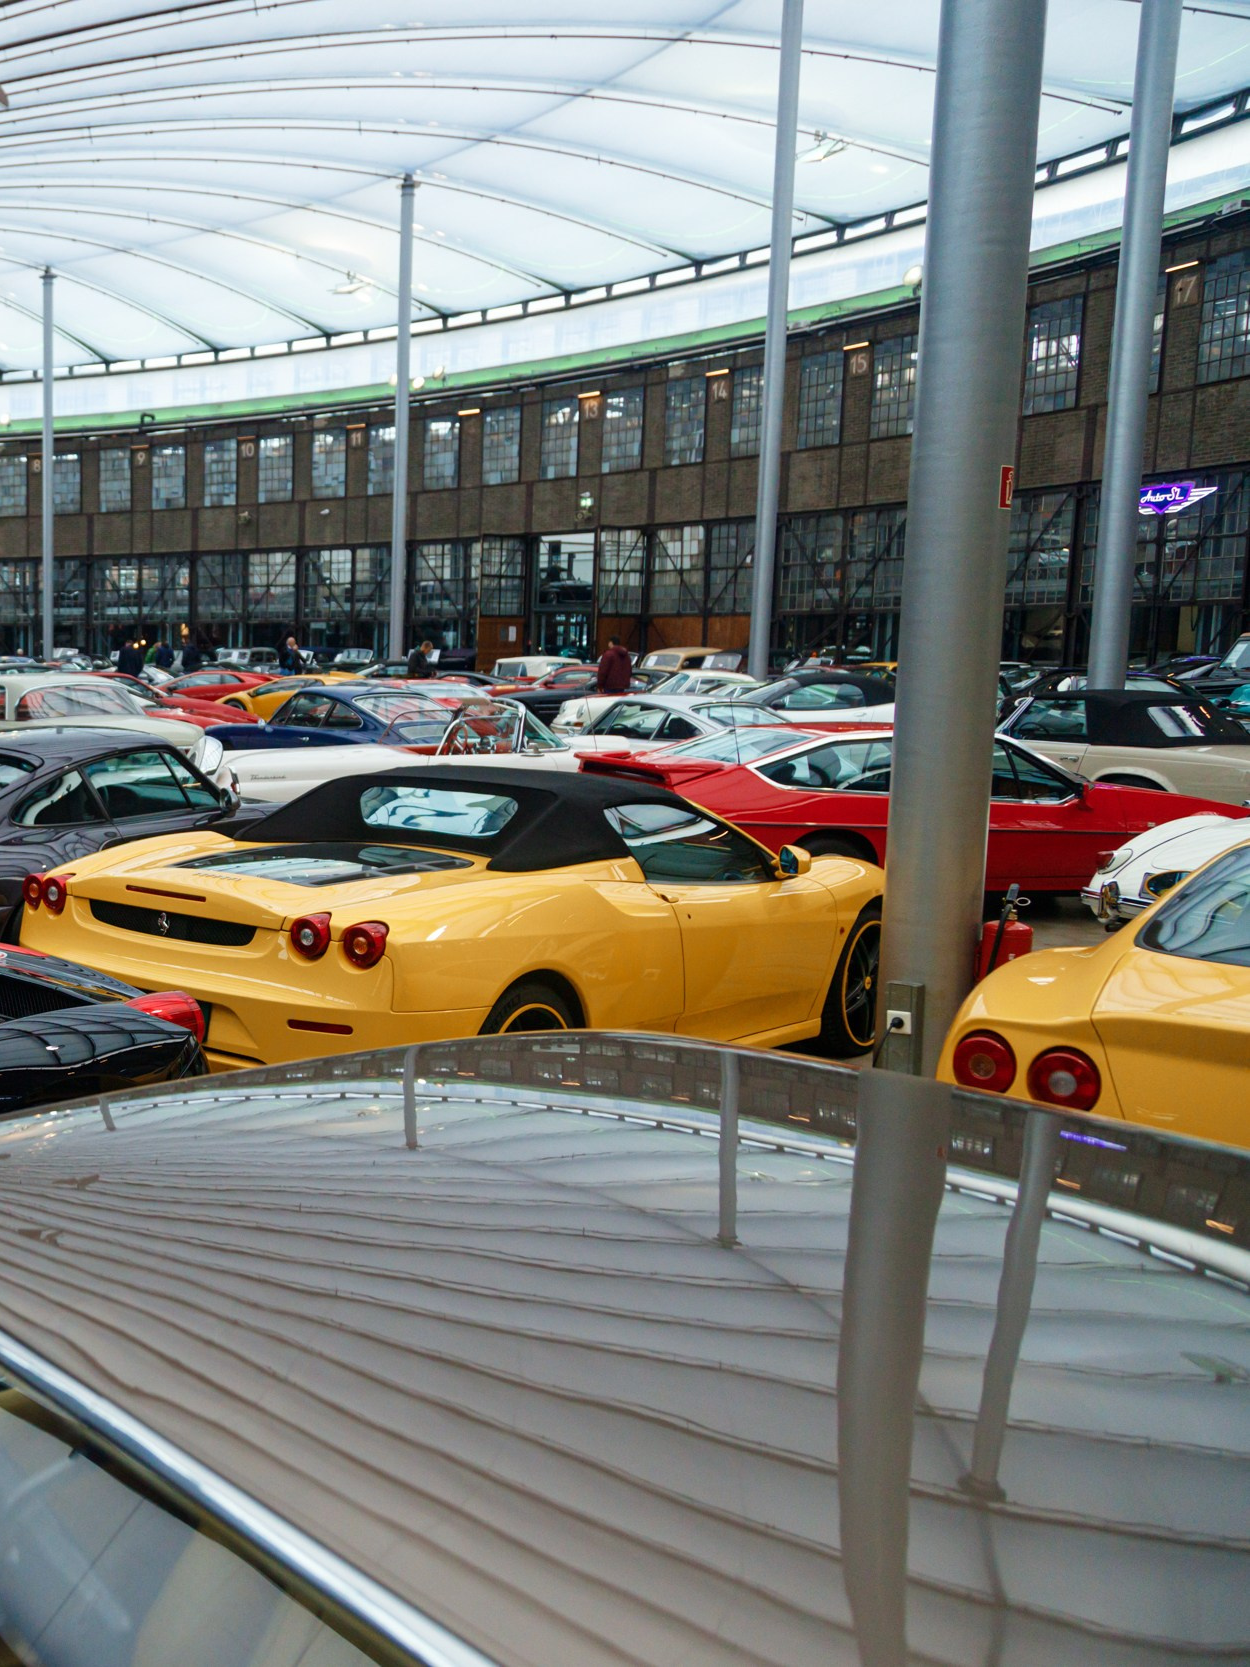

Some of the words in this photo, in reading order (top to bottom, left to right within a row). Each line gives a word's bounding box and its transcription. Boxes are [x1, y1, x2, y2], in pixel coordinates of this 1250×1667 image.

[850, 352, 868, 374] 15
[712, 381, 728, 400] 14
[583, 402, 599, 419] 13
[350, 431, 362, 447] 11
[241, 442, 255, 457] 10
[33, 459, 41, 472] 8
[137, 451, 146, 466] 9
